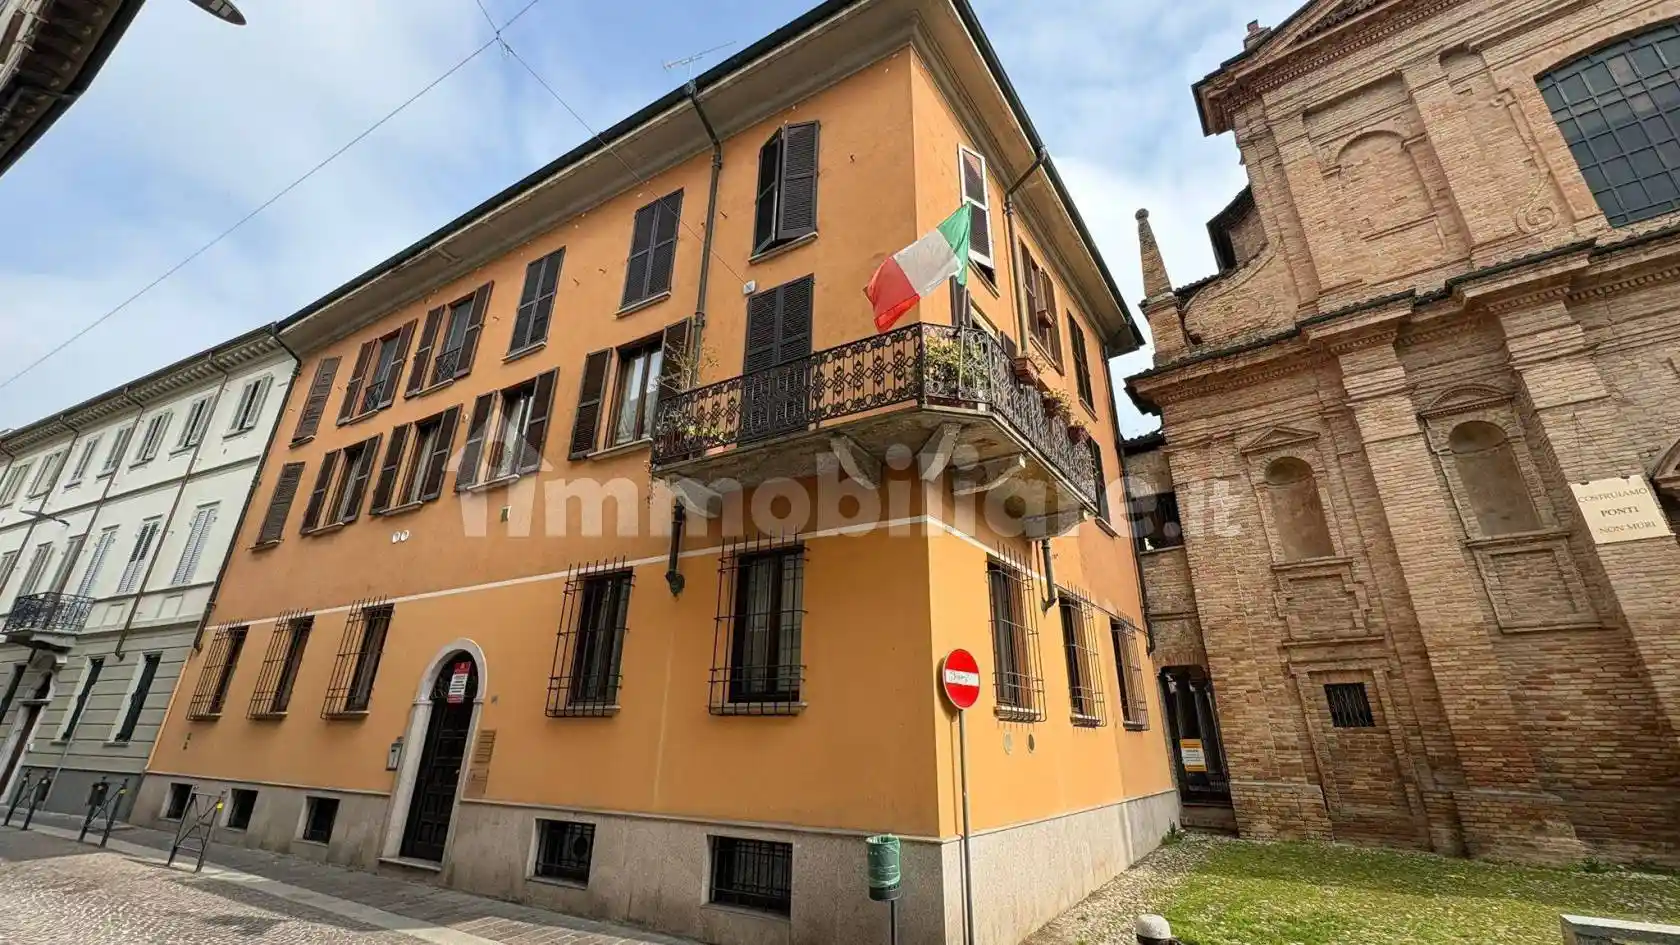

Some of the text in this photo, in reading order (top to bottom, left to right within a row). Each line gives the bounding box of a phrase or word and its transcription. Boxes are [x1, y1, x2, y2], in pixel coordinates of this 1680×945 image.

[1579, 487, 1648, 502] COSTRUIAMO
[1600, 506, 1640, 518] PONTI
[1599, 521, 1656, 534] NON MURI
